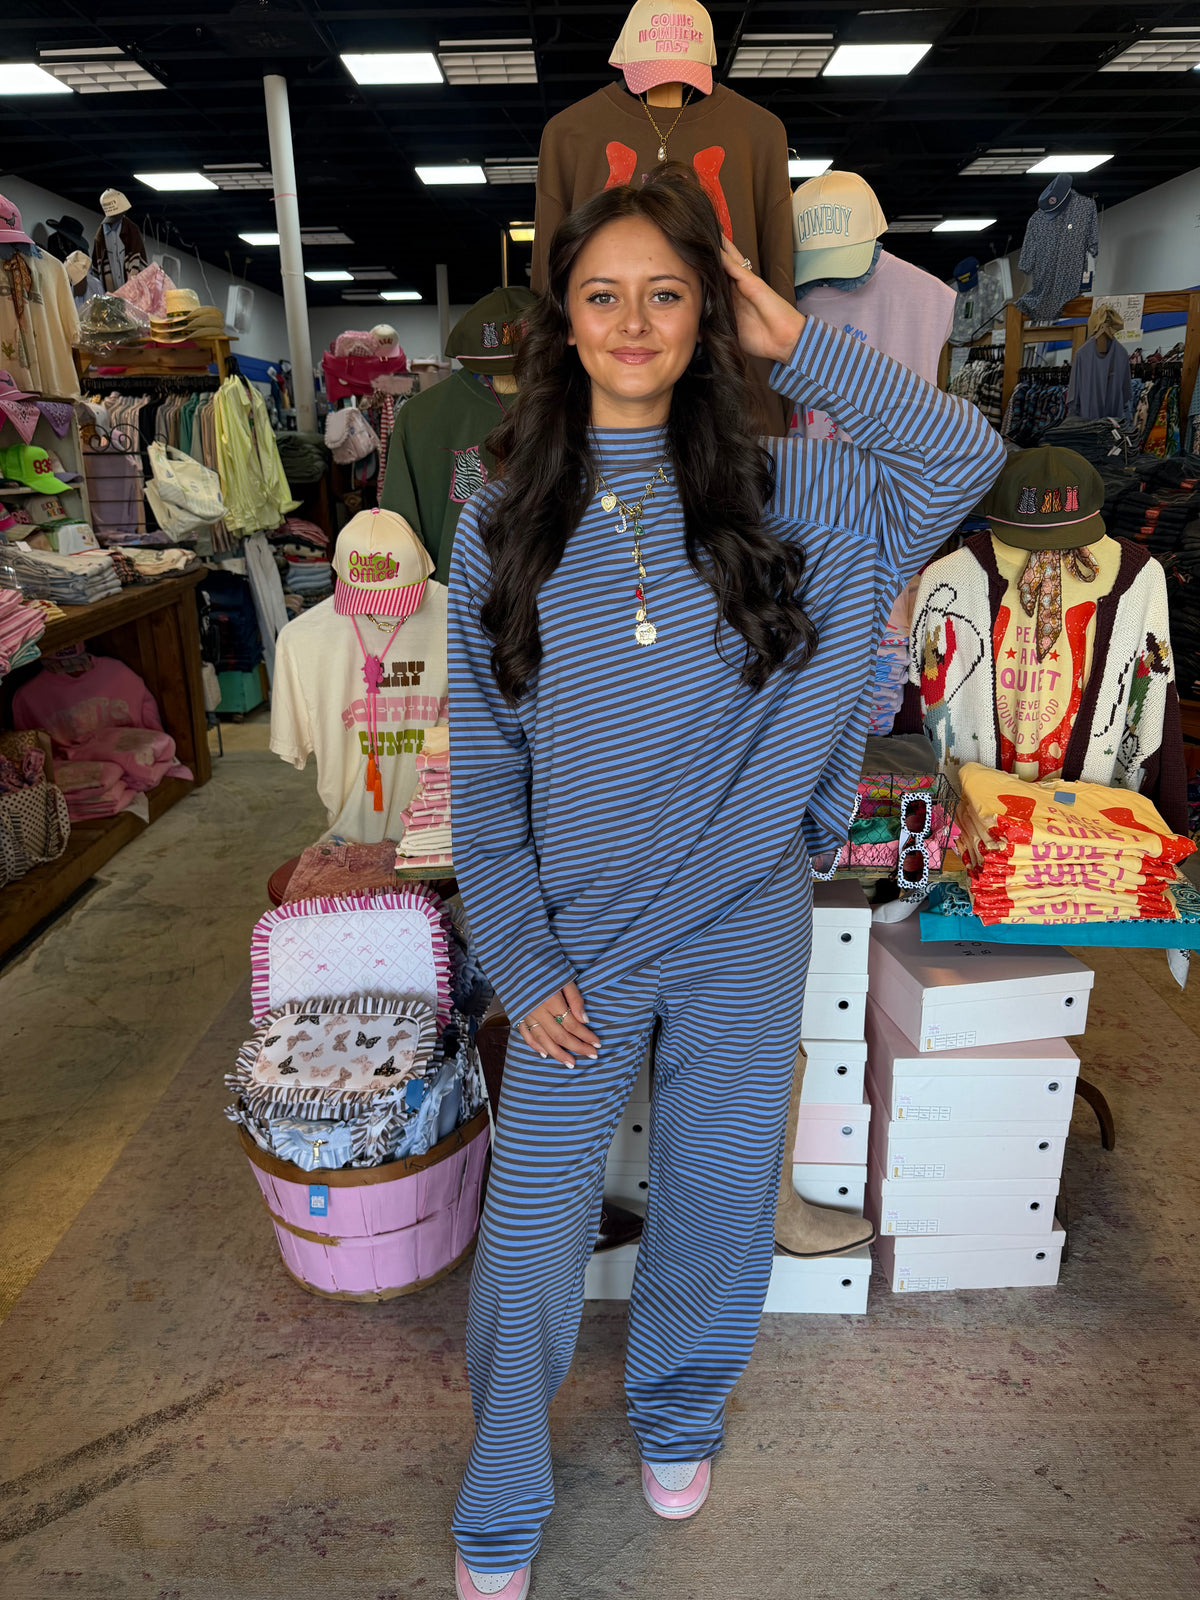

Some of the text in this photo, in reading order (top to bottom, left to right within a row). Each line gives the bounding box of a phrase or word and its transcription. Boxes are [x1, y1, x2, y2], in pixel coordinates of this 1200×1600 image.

[651, 13, 694, 27] GOING
[638, 27, 704, 43] NOWHERE
[656, 40, 690, 53] FAST
[798, 203, 852, 244] COWBOY
[349, 550, 393, 571] Out of
[349, 561, 400, 583] Office!
[376, 660, 425, 687] LAY
[1000, 667, 1062, 693] QUIET
